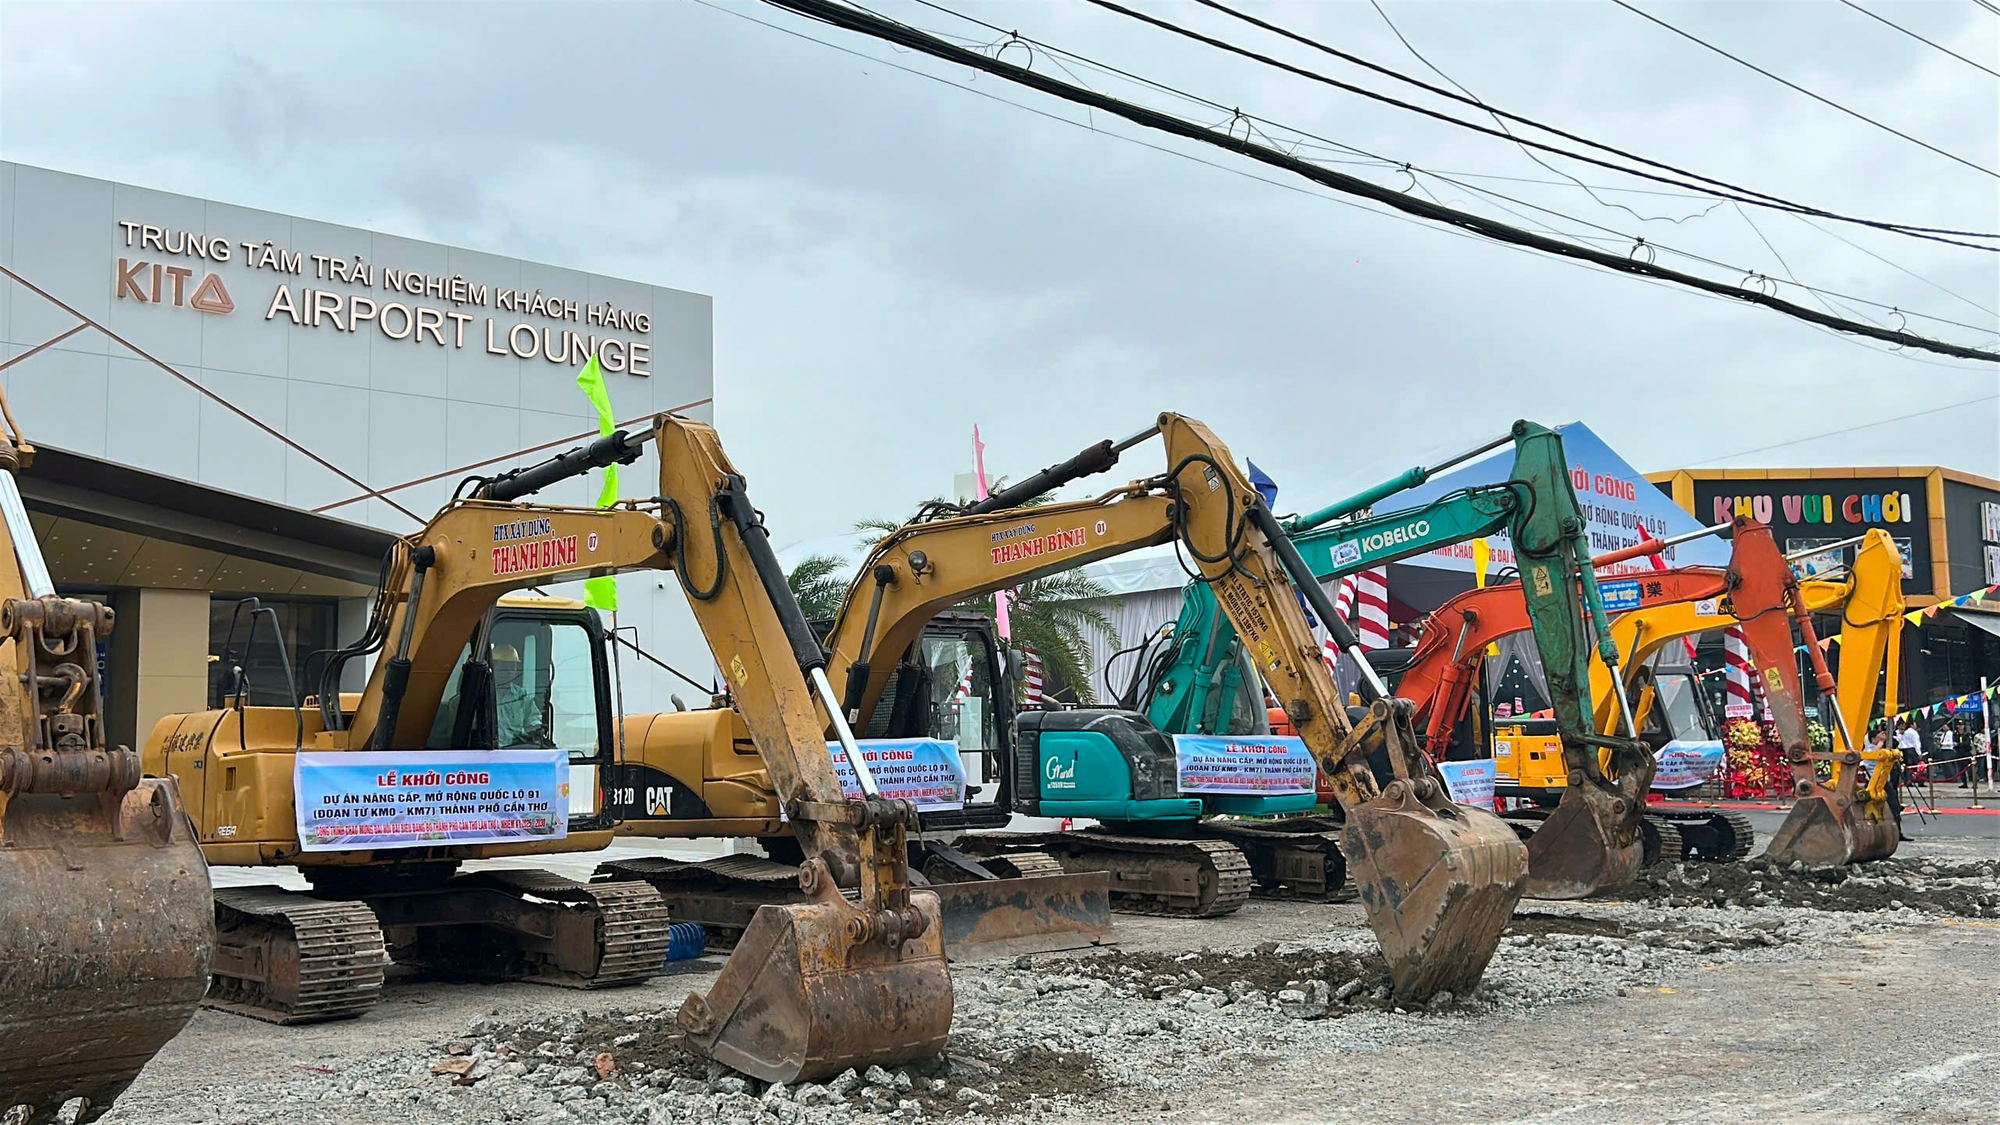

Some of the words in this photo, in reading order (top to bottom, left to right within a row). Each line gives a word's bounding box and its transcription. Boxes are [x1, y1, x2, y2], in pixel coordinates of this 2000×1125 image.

[119, 220, 231, 262] TRUNG
[241, 240, 303, 275] TÂM
[312, 255, 374, 287] TRẢI
[384, 268, 488, 307] NGHIỆM
[496, 287, 579, 322] KHÁCH
[587, 302, 651, 334] HÀNG
[266, 284, 474, 349] AIRPORT
[486, 318, 651, 377] LOUNGE
[1594, 472, 1636, 502] CÔNG
[1595, 504, 1620, 528] RỘNG
[1657, 519, 1667, 536] 91
[1713, 495, 1773, 525] KHU
[1782, 494, 1834, 525] VUI
[1842, 490, 1912, 524] CHƠI
[494, 524, 509, 541] HTX
[991, 538, 1044, 566] THANH
[1046, 528, 1086, 553] BÌNH
[1096, 522, 1106, 534] 01
[1361, 520, 1431, 553] KOBELCO
[492, 541, 539, 575] THANH
[541, 530, 578, 569] BÌNH
[1236, 583, 1253, 607] STATIC
[881, 750, 913, 761] CÔNG
[1268, 745, 1288, 755] CÔNG
[402, 769, 441, 787] KHỞI
[445, 771, 490, 785] CÔNG
[880, 776, 905, 786] THÀNH
[884, 765, 905, 776] RỘNG
[907, 763, 928, 774] QUỐC
[940, 764, 949, 772] 91
[313, 808, 350, 820] (ĐOẠN
[371, 807, 396, 818] KM0
[407, 806, 436, 817] KM7)
[439, 804, 475, 815] THÀNH
[478, 801, 501, 813] PHỐ
[527, 801, 549, 812] THƠ
[323, 794, 341, 806] DỰ
[343, 792, 360, 804] ÁN
[363, 792, 395, 804] NÂNG
[398, 790, 422, 803] CẤP,
[425, 789, 444, 802] MỞ
[446, 790, 477, 803] RỘNG
[480, 788, 510, 800] QUỐC
[512, 788, 524, 801] LỘ
[528, 790, 540, 799] 91
[613, 787, 635, 805] 312D
[646, 786, 674, 816] CAT
